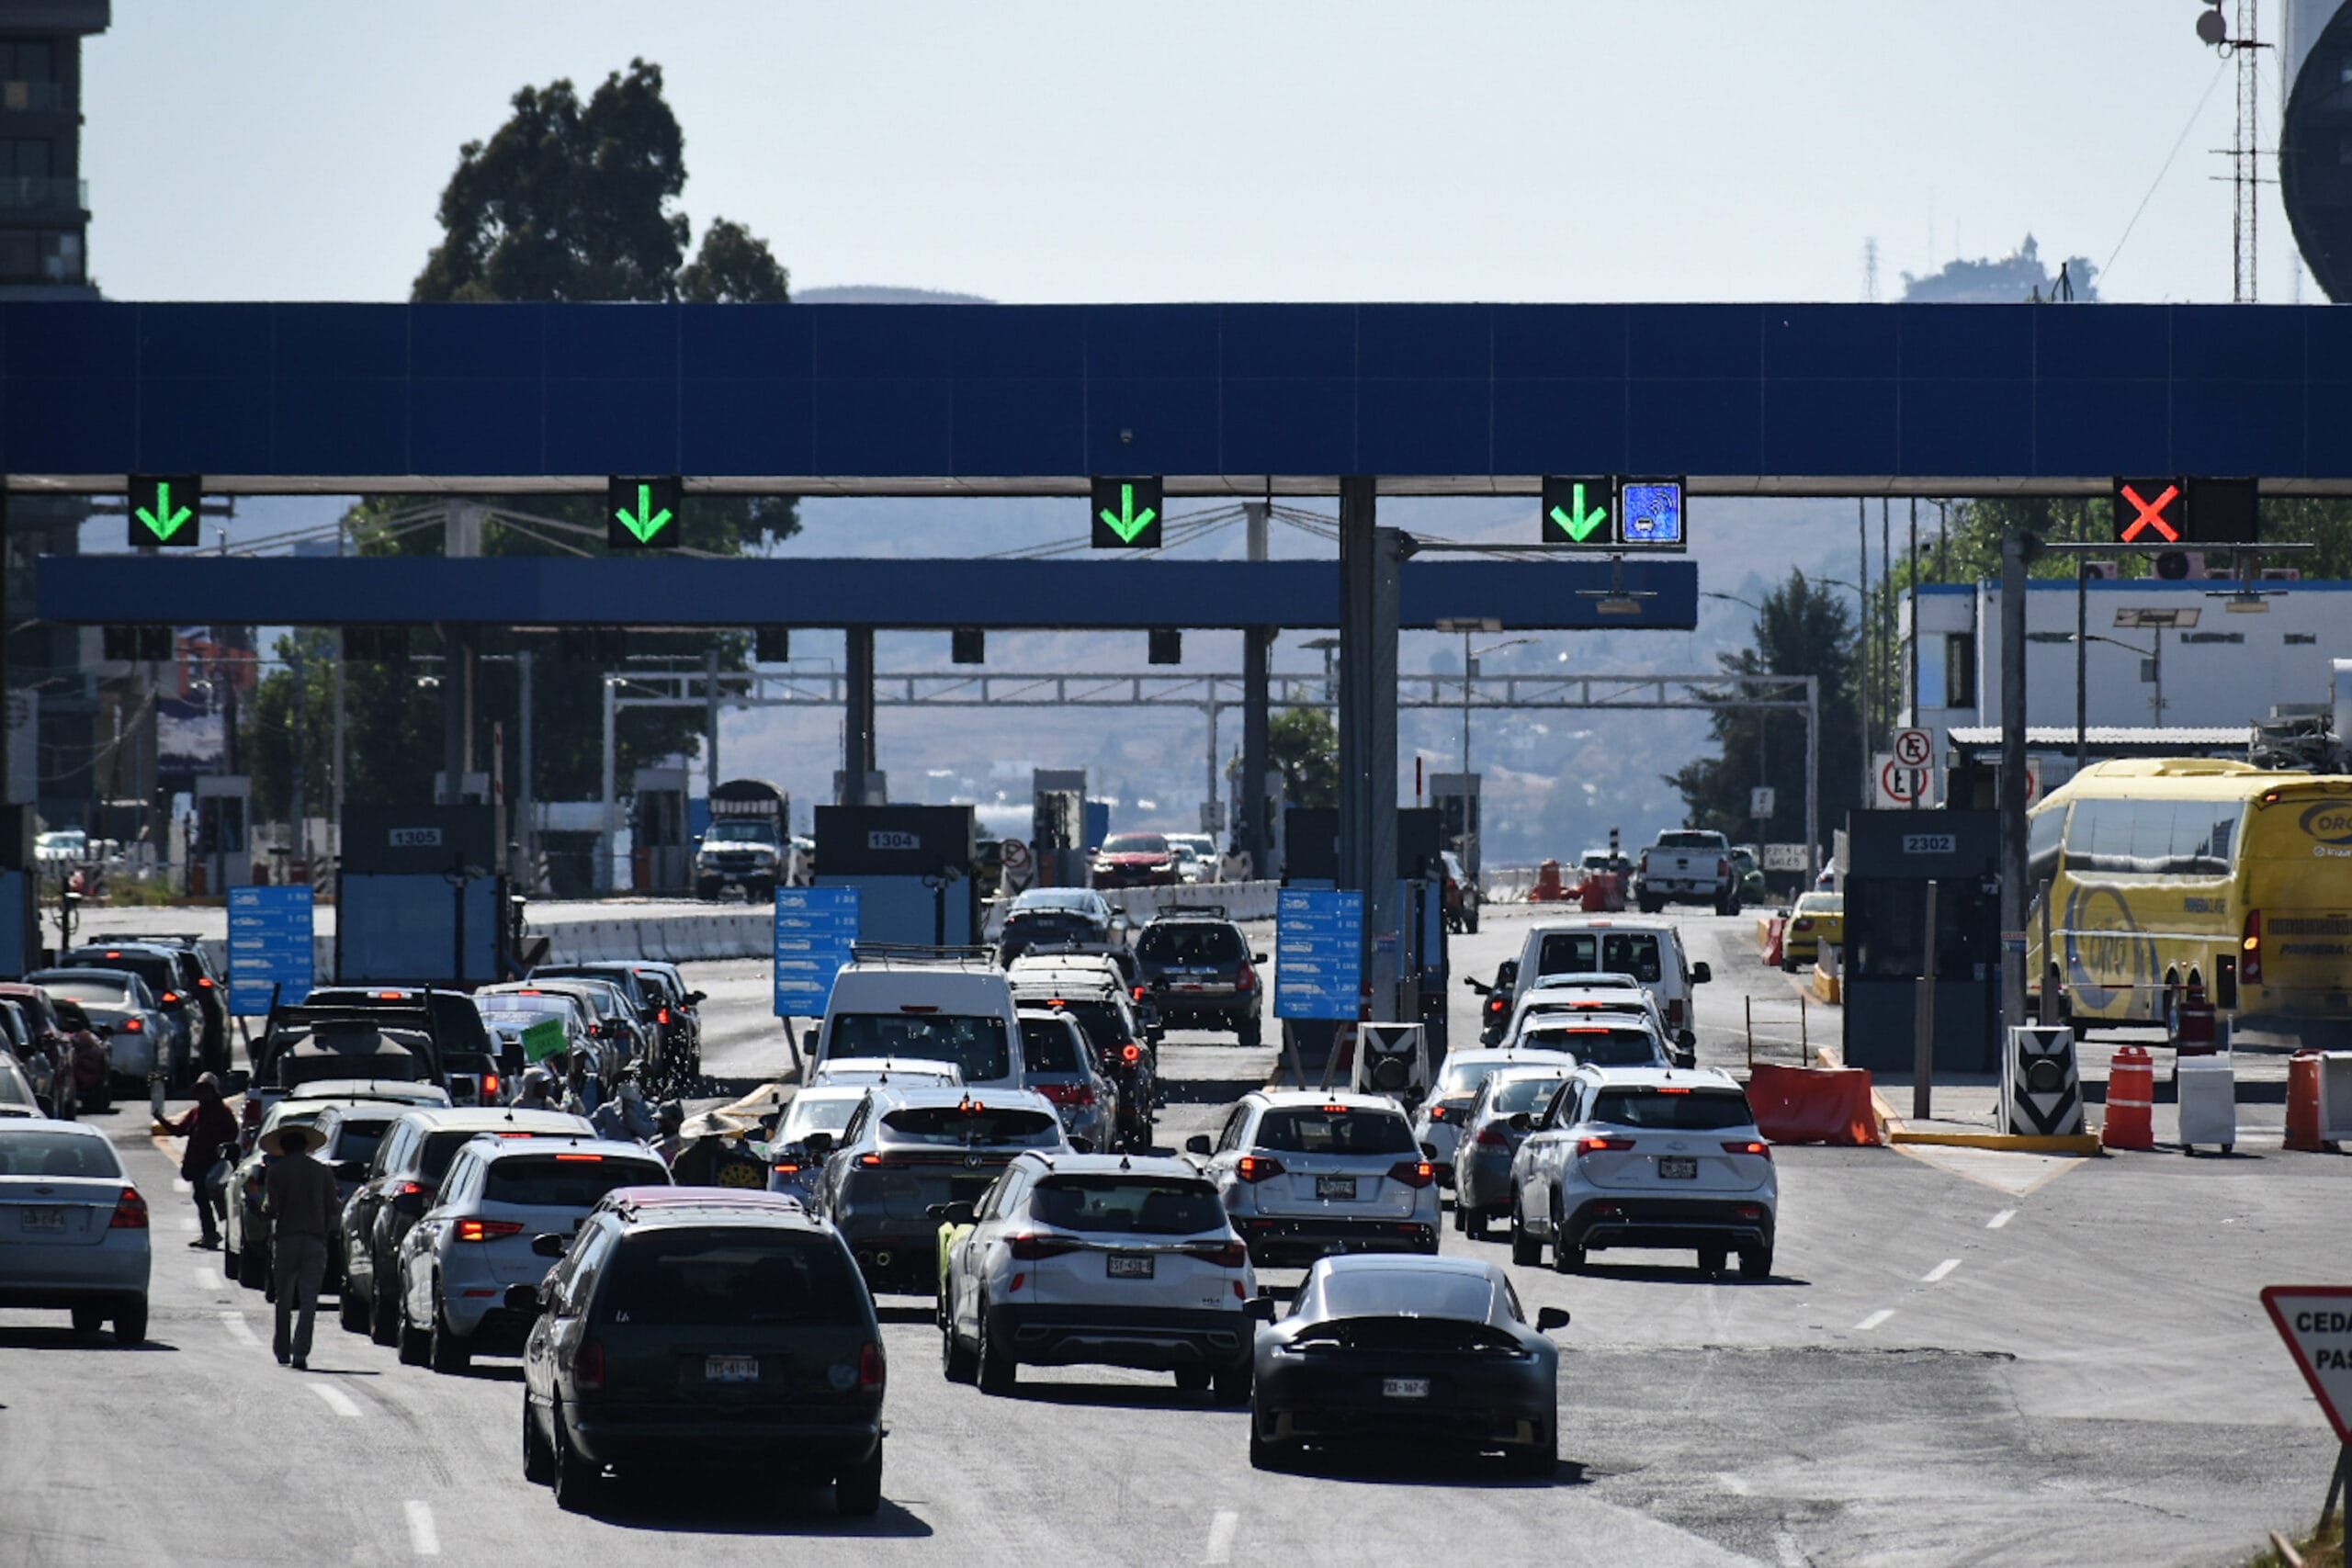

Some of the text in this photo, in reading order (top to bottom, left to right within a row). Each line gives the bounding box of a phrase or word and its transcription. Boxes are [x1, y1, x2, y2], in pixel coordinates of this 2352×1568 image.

[1906, 739, 1920, 758] E
[394, 830, 436, 844] 1305
[871, 833, 912, 847] 1304
[1908, 837, 1950, 851] 2302
